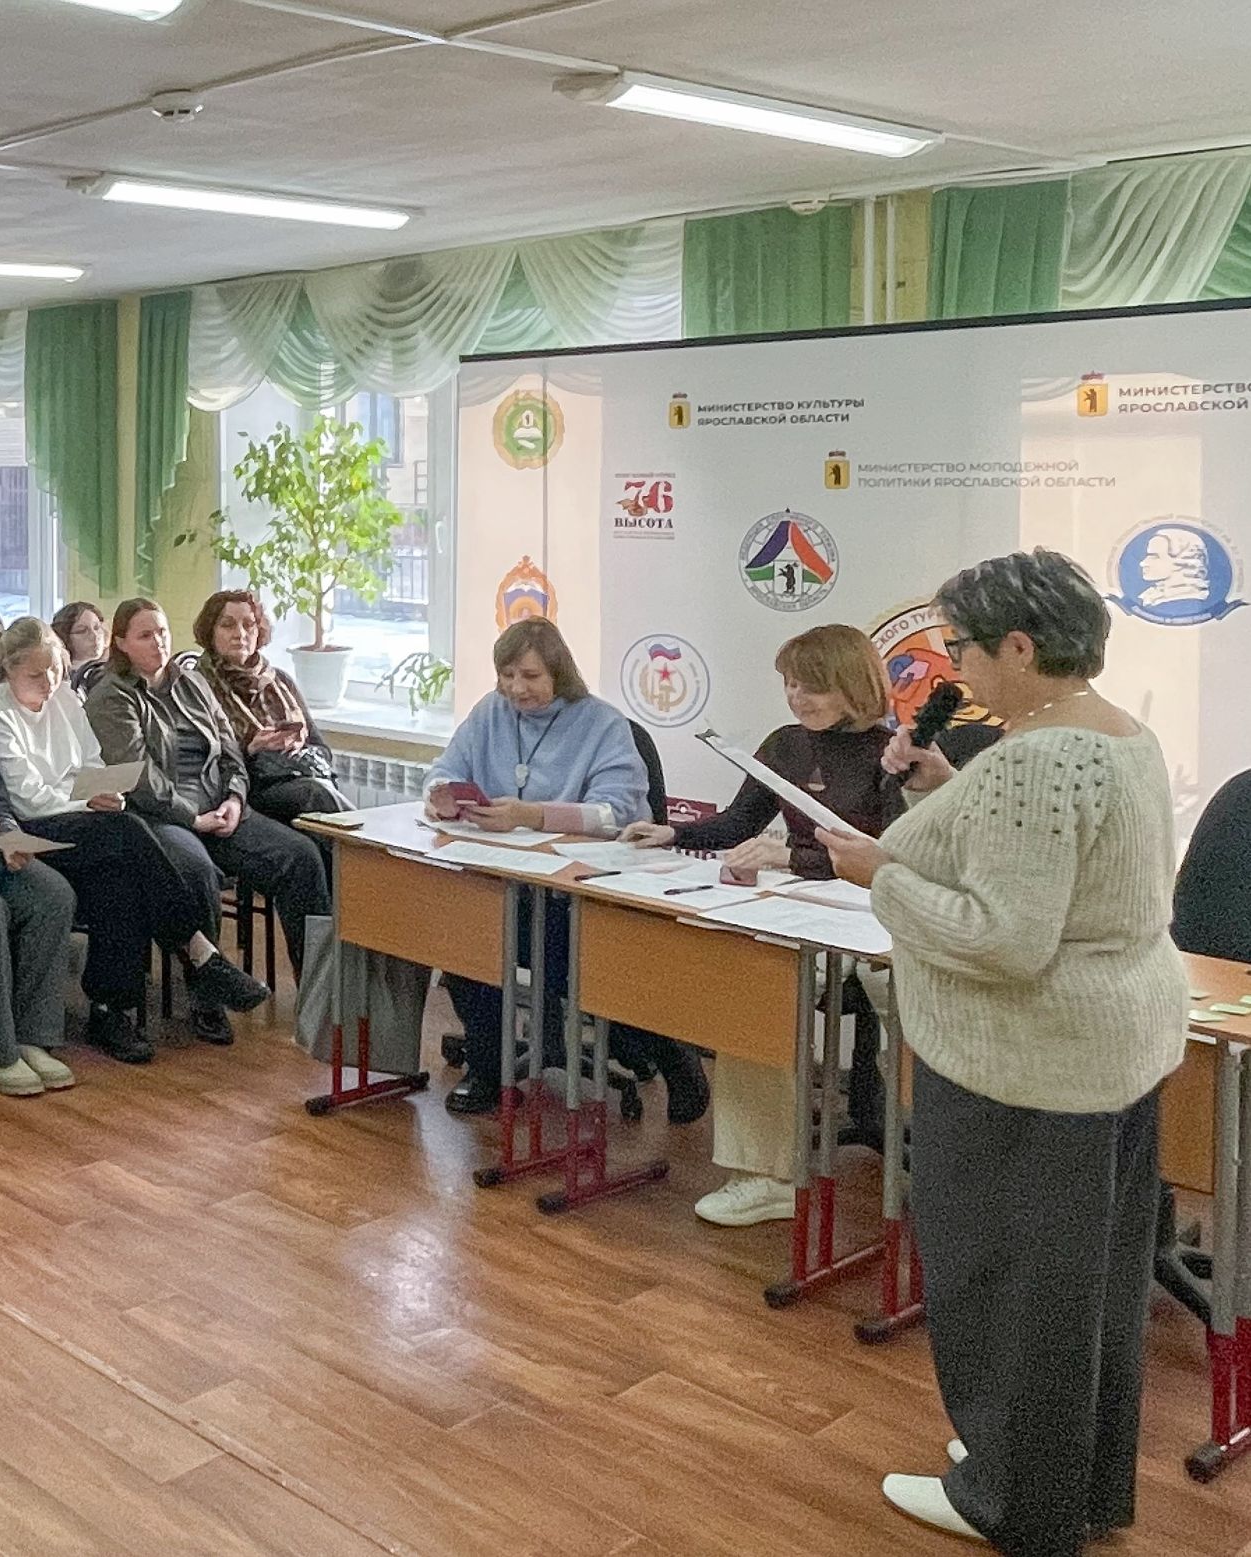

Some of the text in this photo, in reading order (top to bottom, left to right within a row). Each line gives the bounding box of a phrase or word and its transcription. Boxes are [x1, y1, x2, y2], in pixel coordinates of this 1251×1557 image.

[697, 398, 865, 413] МИНИСТЕРСТВО КУЛЬТУРЫ
[1118, 397, 1249, 413] ЯРОСЛАВСКОЙ
[697, 413, 850, 426] ЯРОСЛАВСКОЙ ОБЛАСТИ
[857, 462, 966, 474] МИНИСТЕРСТВО
[857, 474, 1117, 488] ПОЛИТИКИ ЯРОСЛАВСКОЙ ОБЛАСТИ
[614, 518, 674, 529] ВЫСОТА
